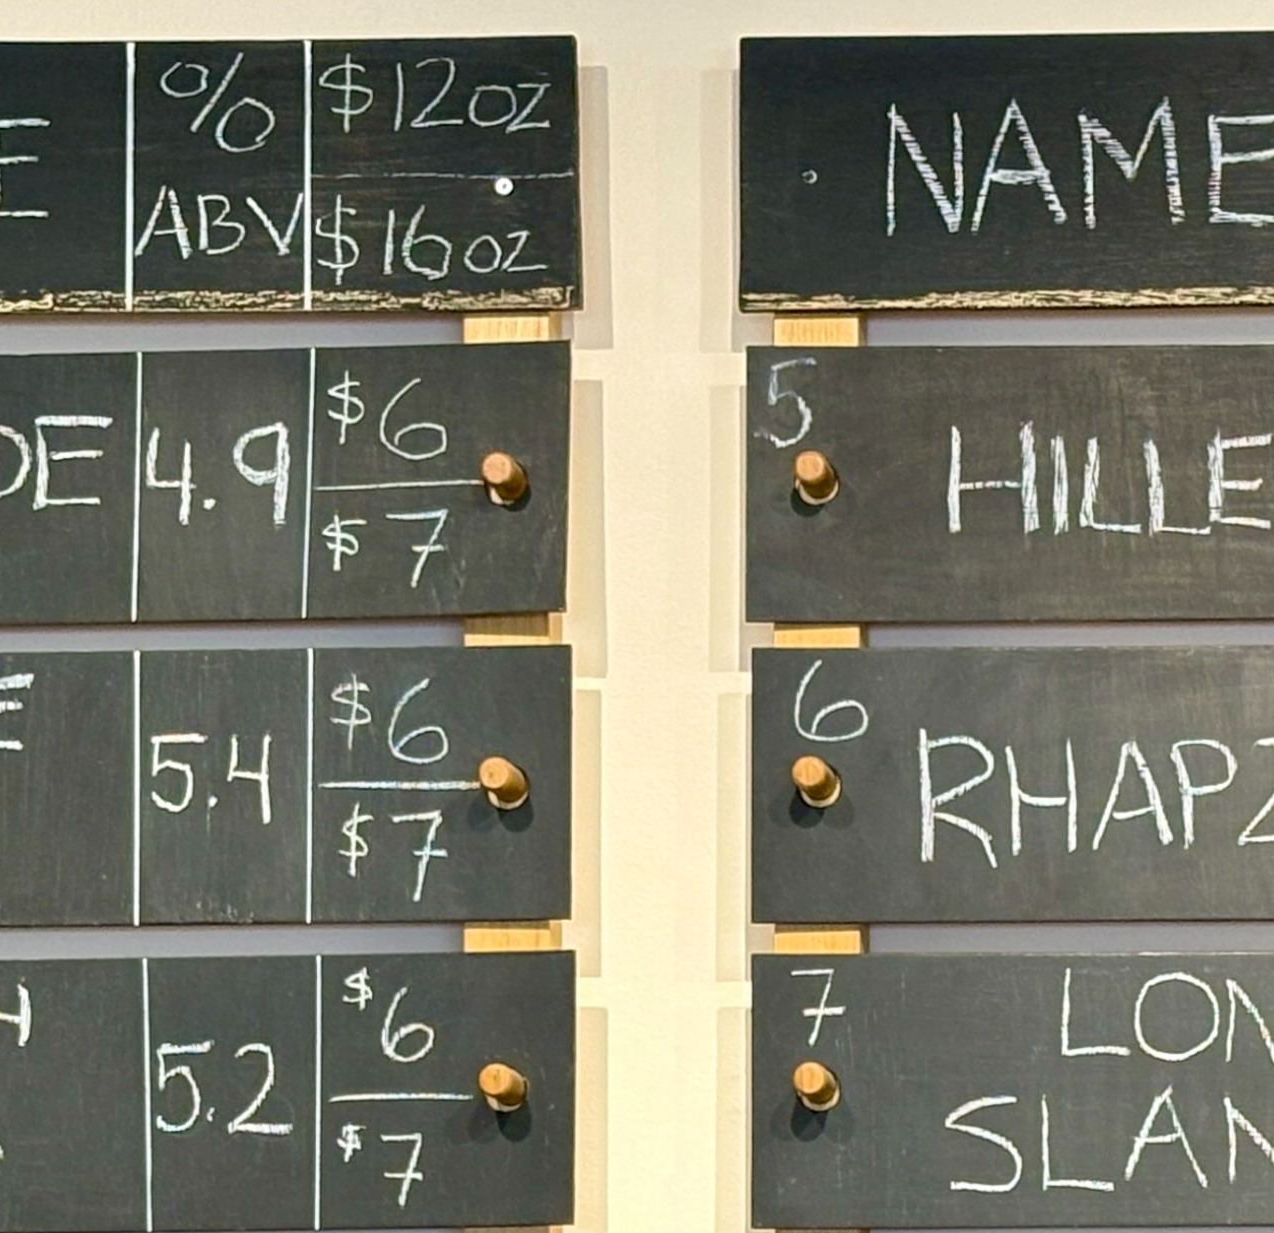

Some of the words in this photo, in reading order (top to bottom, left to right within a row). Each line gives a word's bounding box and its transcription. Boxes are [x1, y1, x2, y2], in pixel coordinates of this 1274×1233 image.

[159, 52, 276, 154] %
[135, 185, 302, 260] ABV
[326, 371, 448, 460] $6
[754, 358, 817, 449] 5
[146, 423, 292, 529] 4.9
[331, 673, 450, 765] $6
[793, 659, 870, 743] 6
[149, 733, 273, 824] 5.4
[343, 968, 435, 1063] $6
[792, 968, 846, 1046] 7
[154, 1041, 293, 1136] 5.2
[336, 1125, 425, 1207] $7
